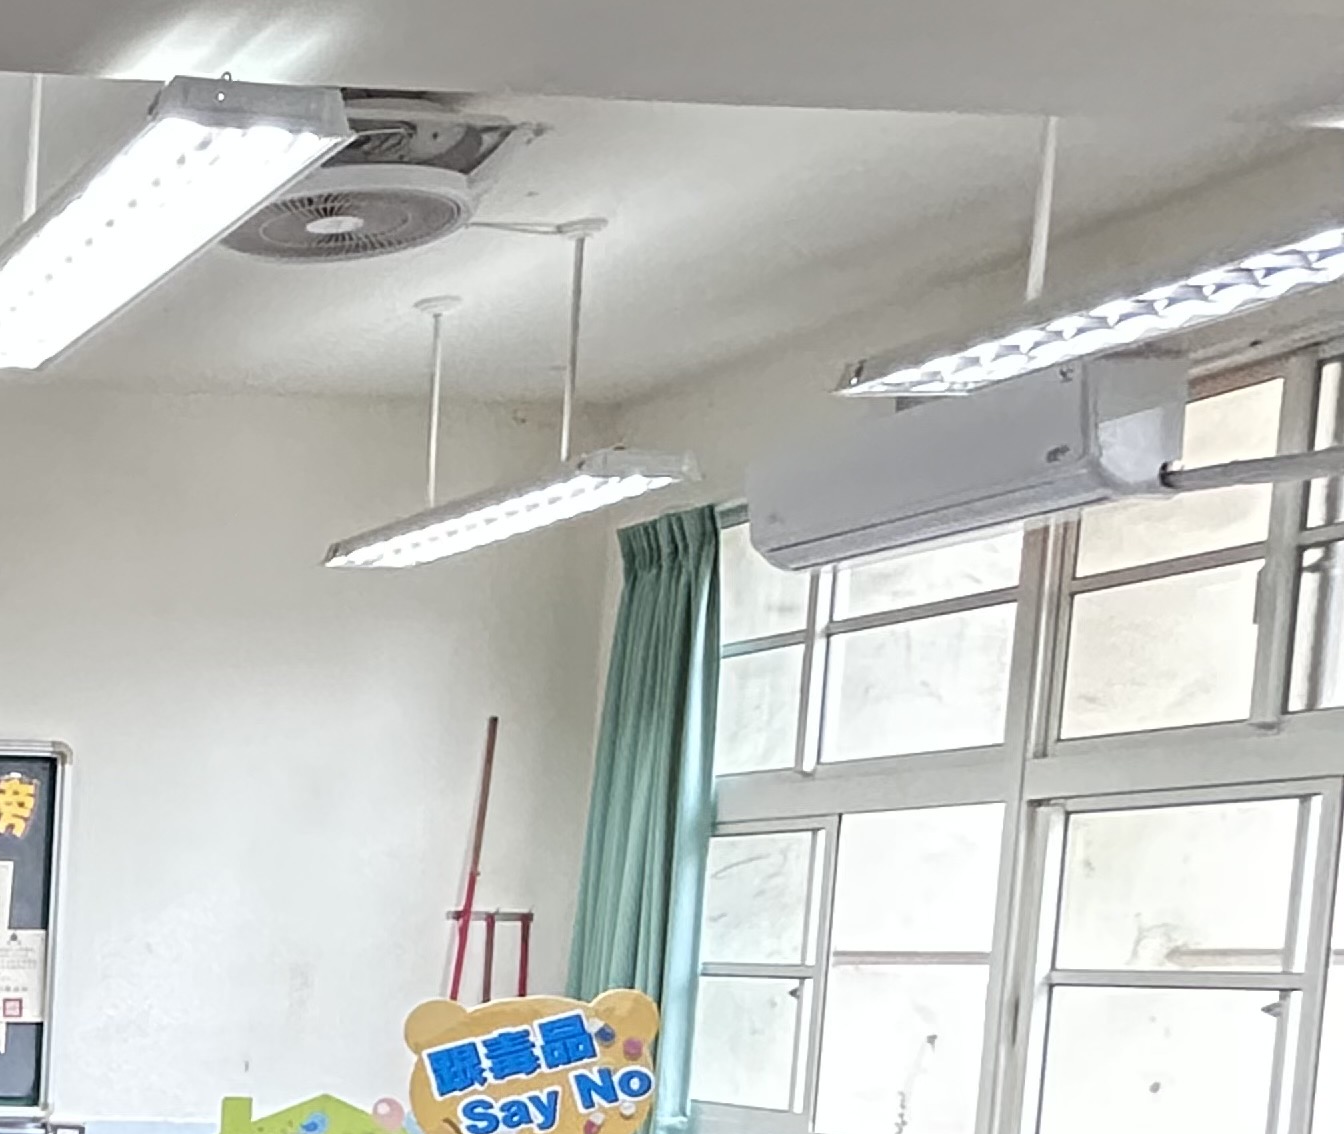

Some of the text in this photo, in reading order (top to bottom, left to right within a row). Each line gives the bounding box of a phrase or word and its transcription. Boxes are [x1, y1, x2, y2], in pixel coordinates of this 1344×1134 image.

[427, 1012, 597, 1098] 跟毒品
[572, 1067, 653, 1110] No
